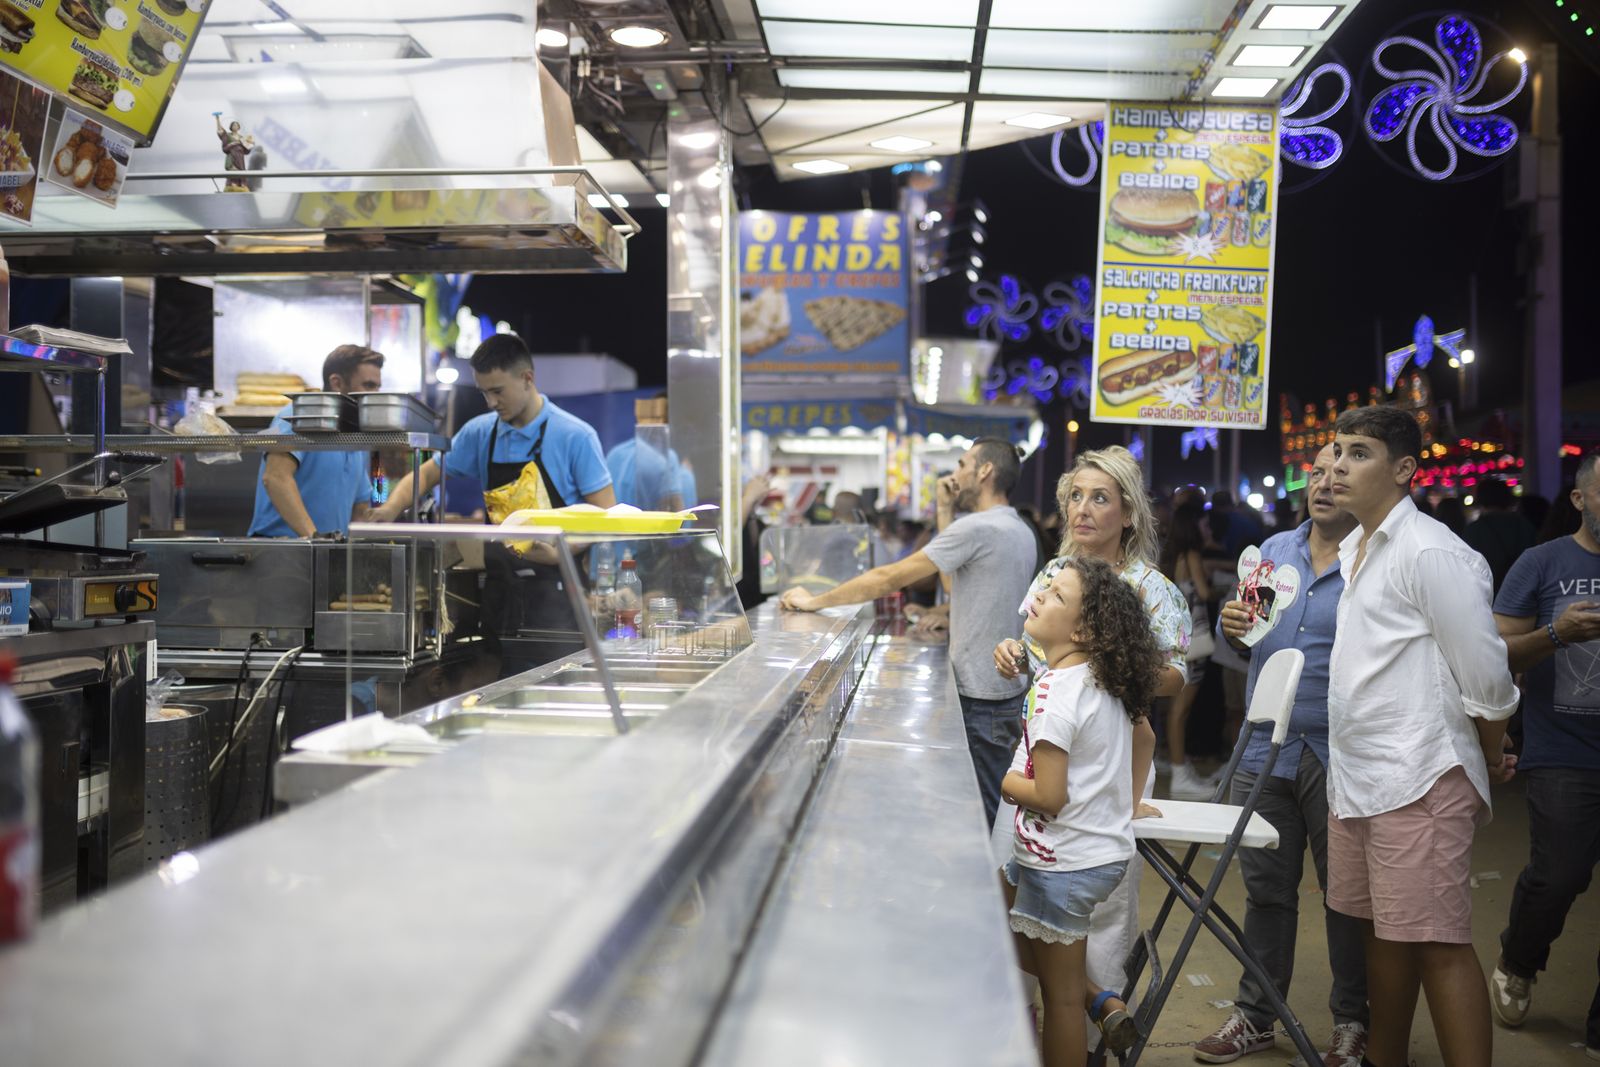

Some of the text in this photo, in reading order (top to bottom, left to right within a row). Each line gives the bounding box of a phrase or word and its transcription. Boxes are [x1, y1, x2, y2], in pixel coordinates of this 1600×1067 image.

[137, 1, 166, 28] Hamburguesa
[751, 215, 901, 242] OFRES
[745, 243, 902, 272] ELINDA
[749, 406, 851, 427] CREPES
